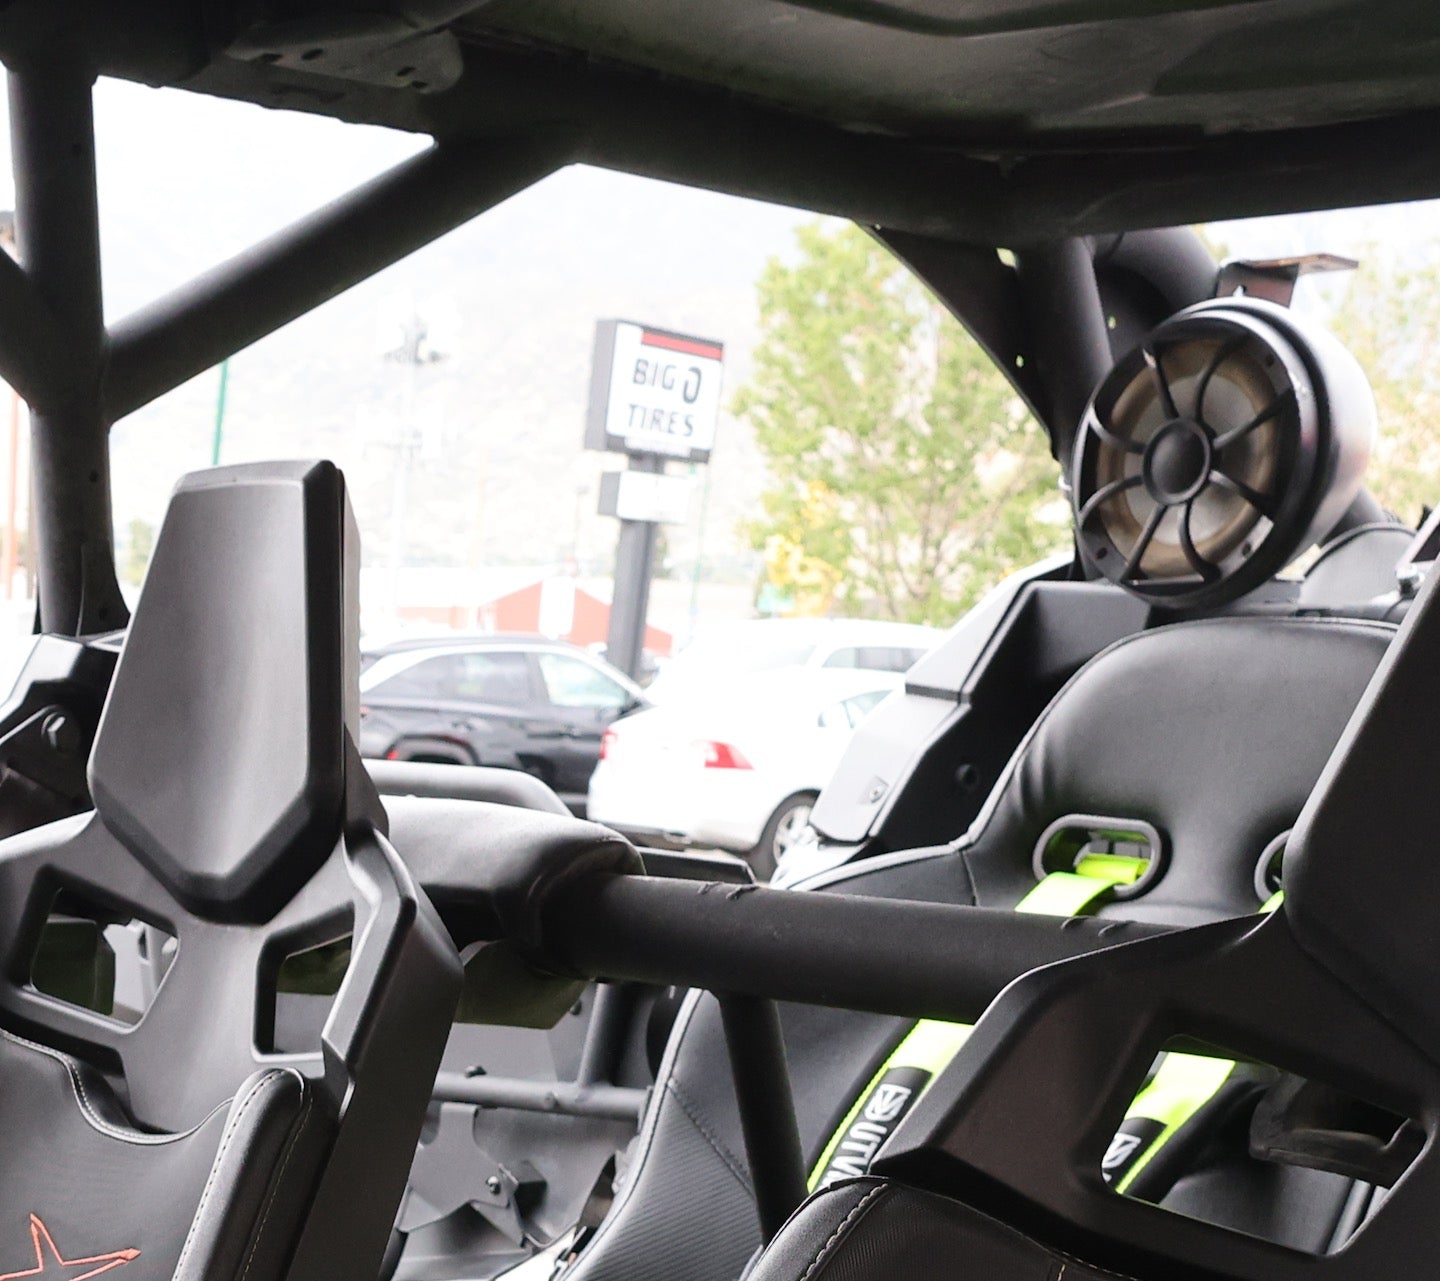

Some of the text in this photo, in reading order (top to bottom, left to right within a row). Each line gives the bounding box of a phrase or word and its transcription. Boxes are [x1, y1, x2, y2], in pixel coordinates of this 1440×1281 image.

[632, 358, 703, 404] BIG O
[627, 403, 695, 438] TIRES
